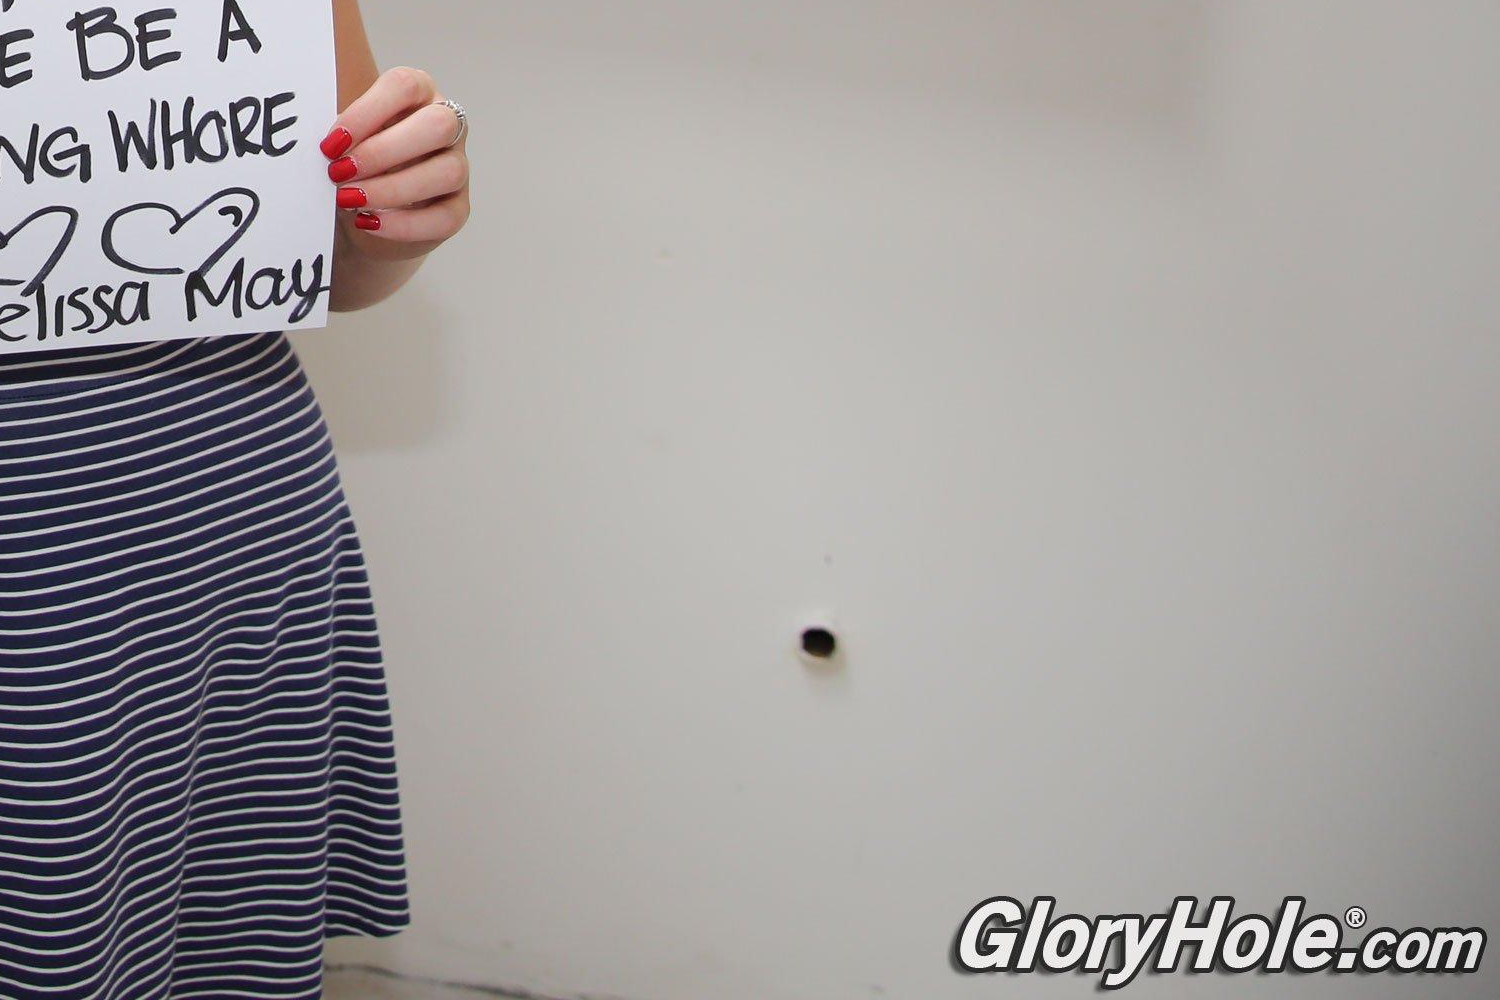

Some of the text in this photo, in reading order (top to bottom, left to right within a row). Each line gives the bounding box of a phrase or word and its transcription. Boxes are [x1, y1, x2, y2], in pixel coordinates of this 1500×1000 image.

[67, 6, 182, 81] BE
[107, 91, 299, 173] WHORE
[186, 253, 330, 324] May
